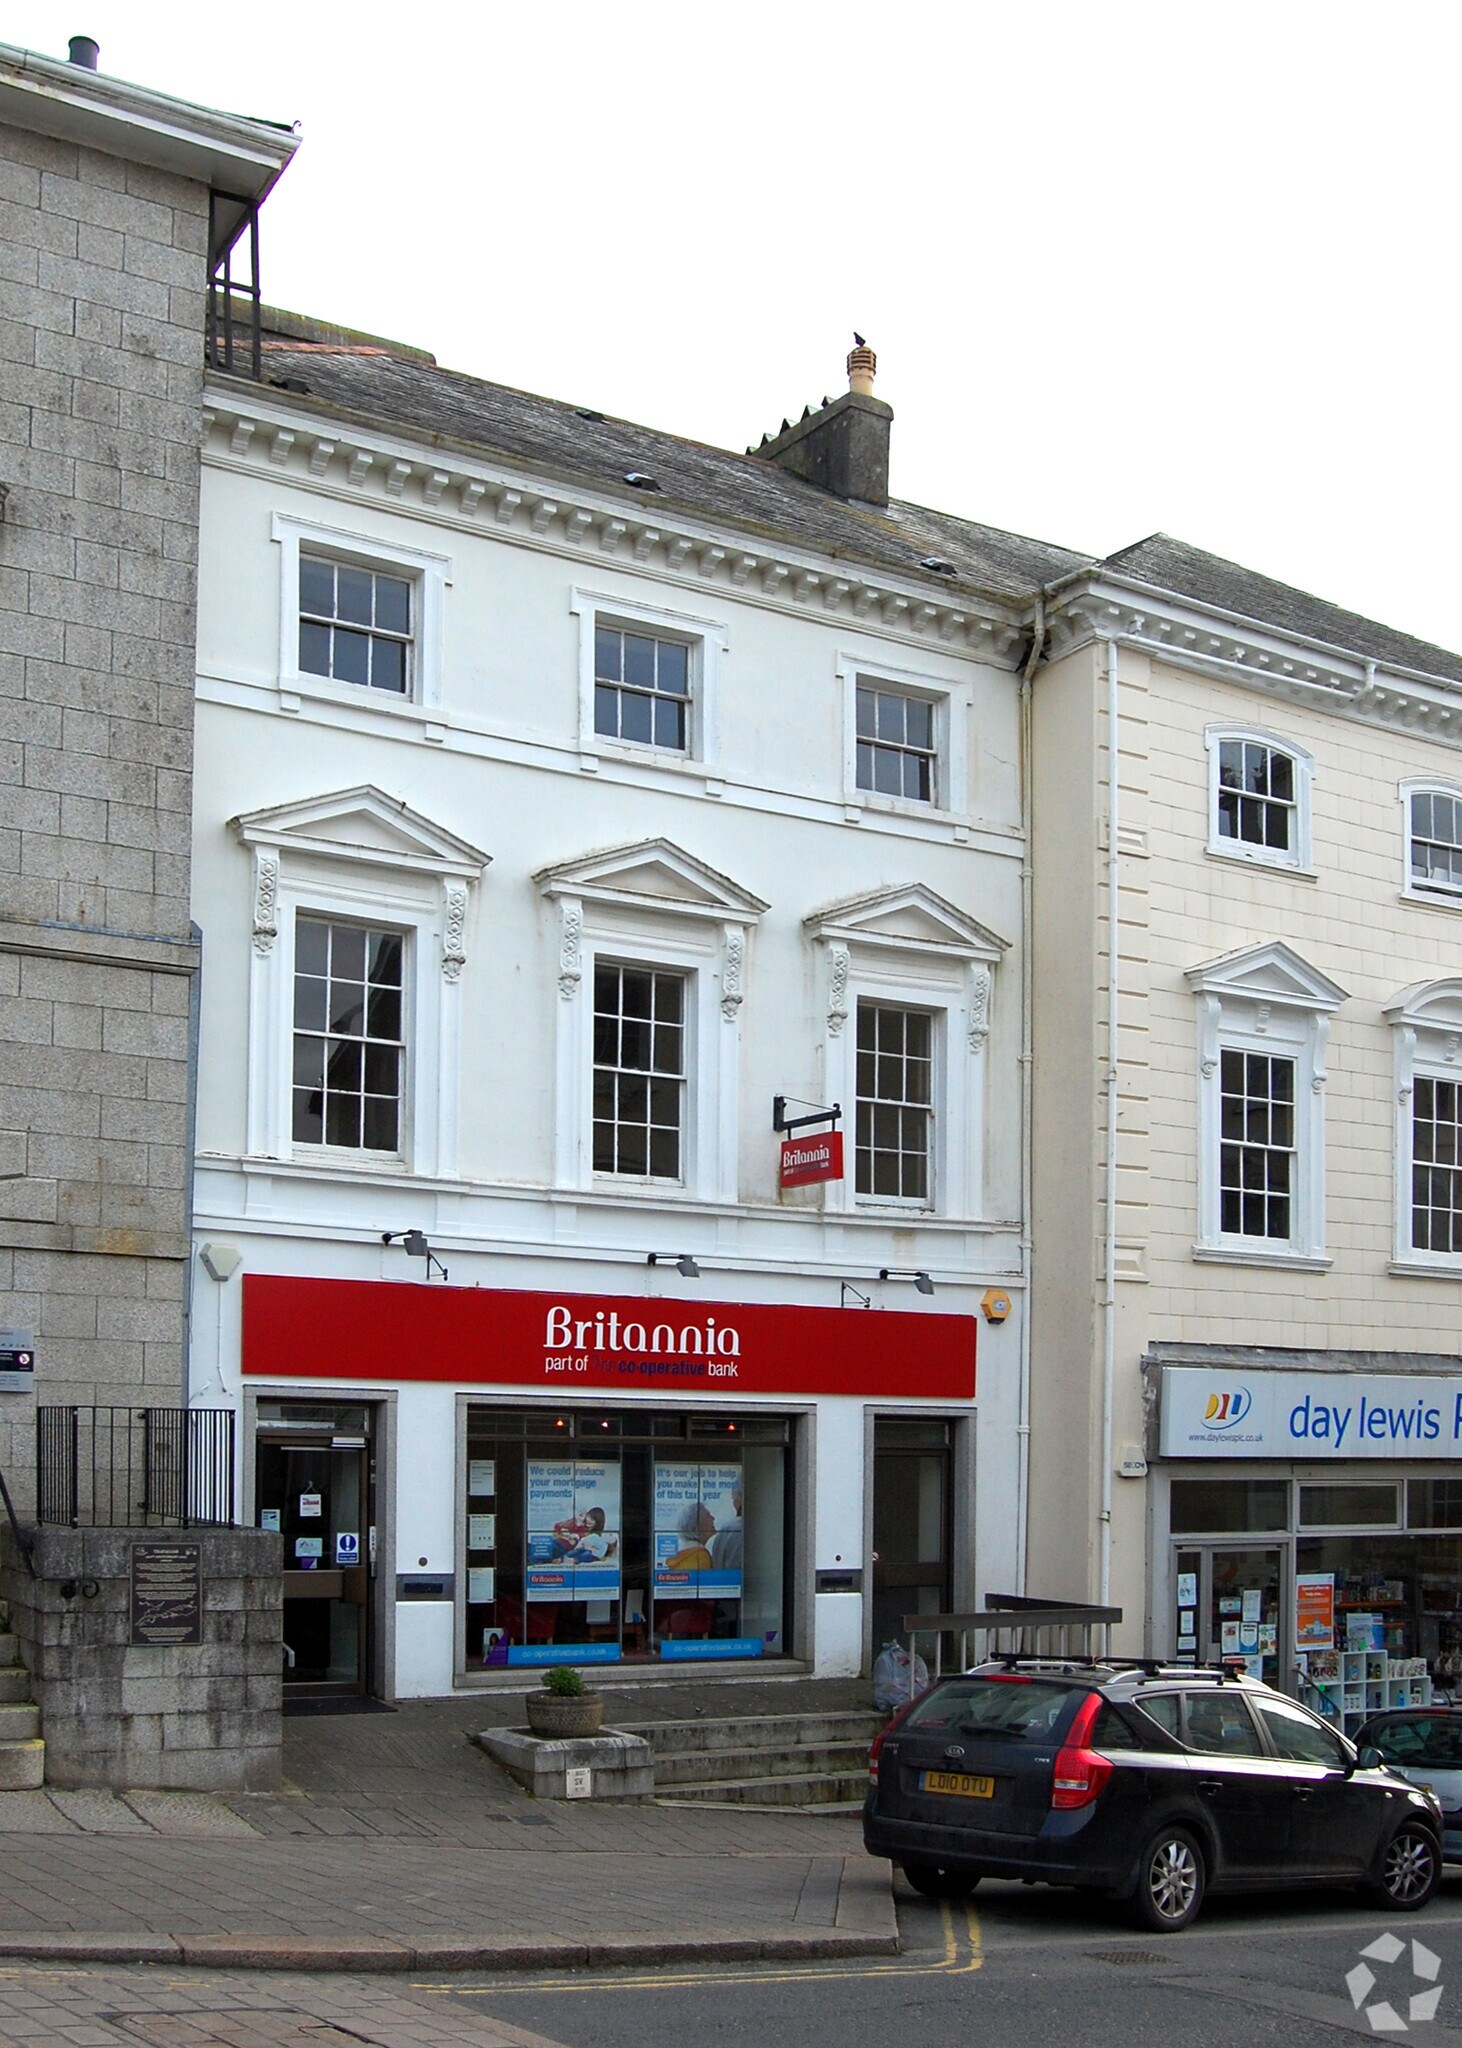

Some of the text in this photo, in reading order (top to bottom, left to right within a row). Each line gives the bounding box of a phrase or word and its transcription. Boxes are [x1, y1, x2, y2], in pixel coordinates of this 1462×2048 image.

[783, 1144, 829, 1168] Britannia
[543, 1306, 741, 1356] Britannia
[545, 1355, 573, 1373] part
[575, 1355, 589, 1371] of
[618, 1359, 705, 1377] co-operative
[708, 1360, 739, 1377] bank
[1290, 1395, 1352, 1449] day
[1359, 1396, 1440, 1440] lewis
[530, 1466, 606, 1477] We could reduce
[656, 1468, 737, 1480] It's our job to help
[530, 1477, 597, 1490] your mortgage
[657, 1480, 739, 1490] you make the most
[530, 1489, 573, 1500] payments
[657, 1490, 721, 1501] of this tax year
[929, 1773, 988, 1793] LD10 OTU
